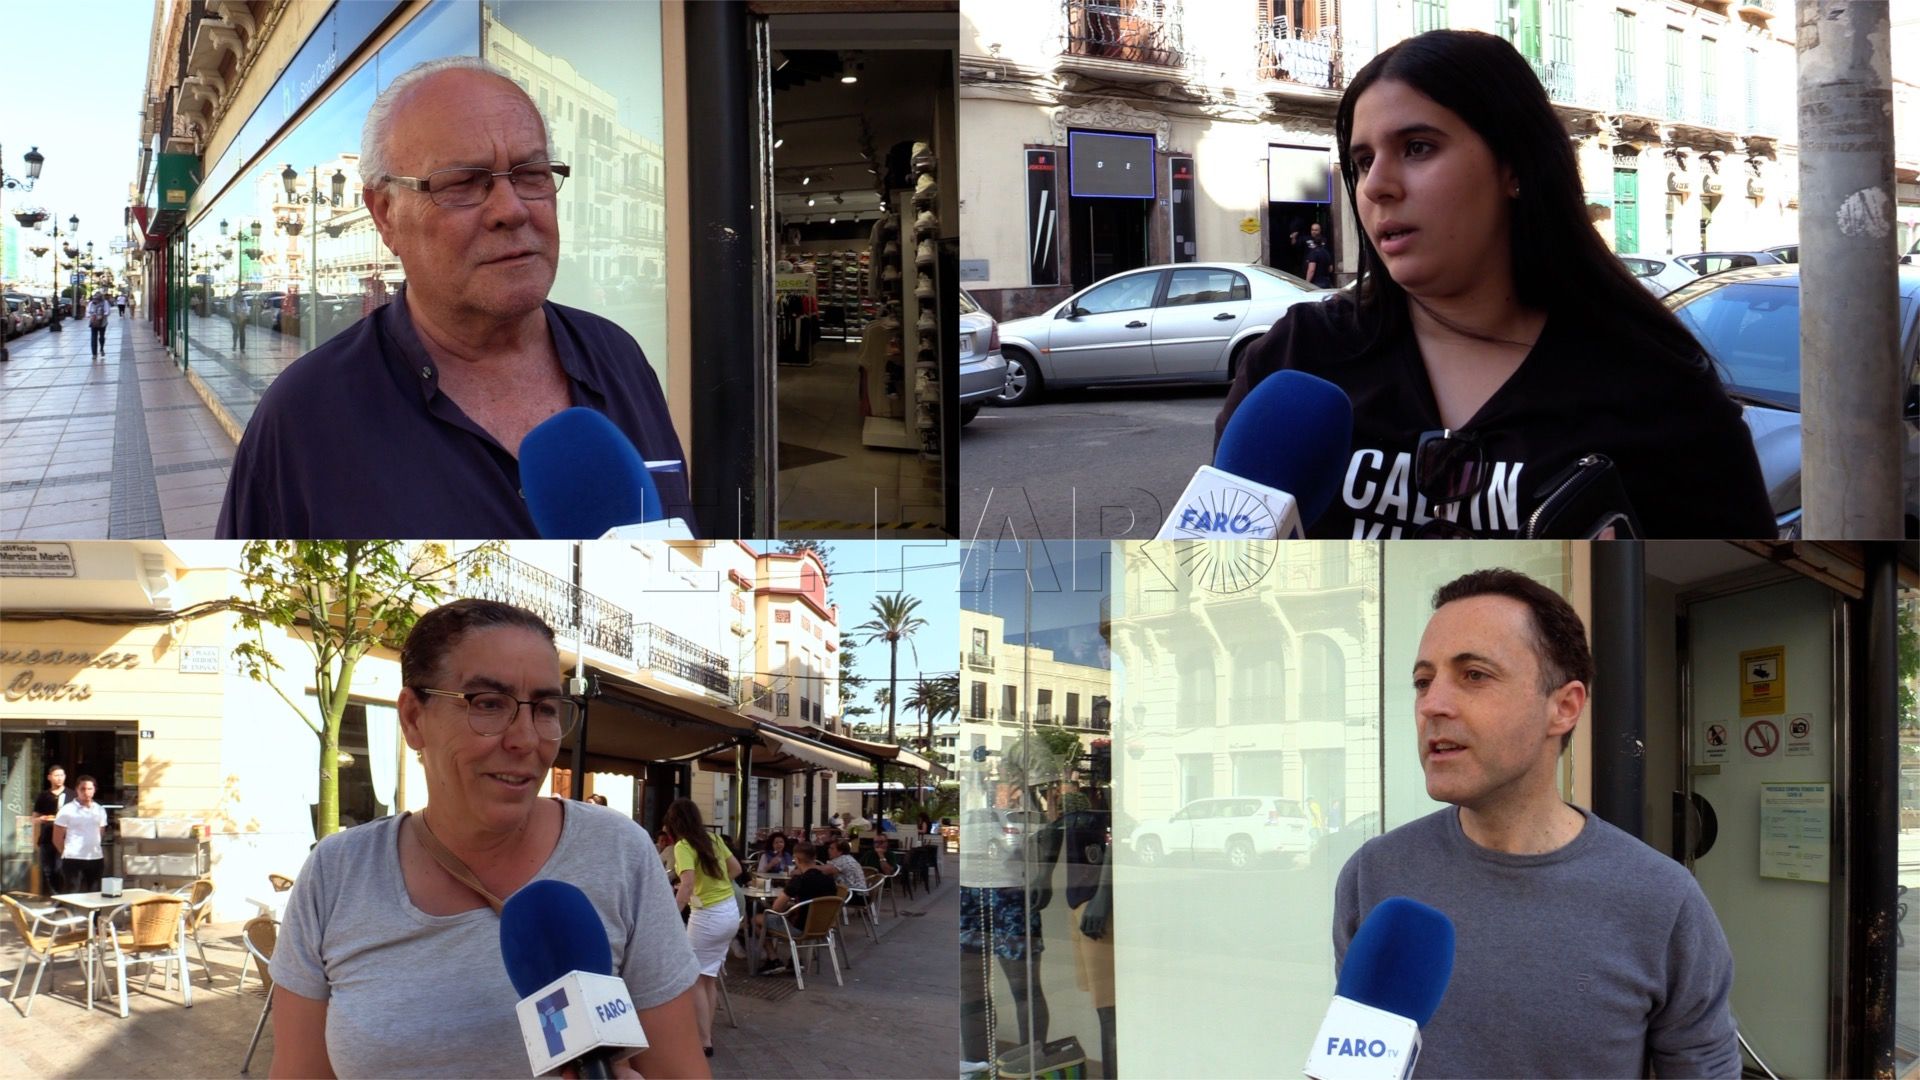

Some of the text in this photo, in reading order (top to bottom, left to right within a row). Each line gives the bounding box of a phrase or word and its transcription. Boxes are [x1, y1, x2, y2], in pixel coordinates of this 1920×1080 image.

[1180, 508, 1252, 535] FARO
[595, 998, 627, 1023] FARO
[1327, 1037, 1399, 1058] FARO TV
